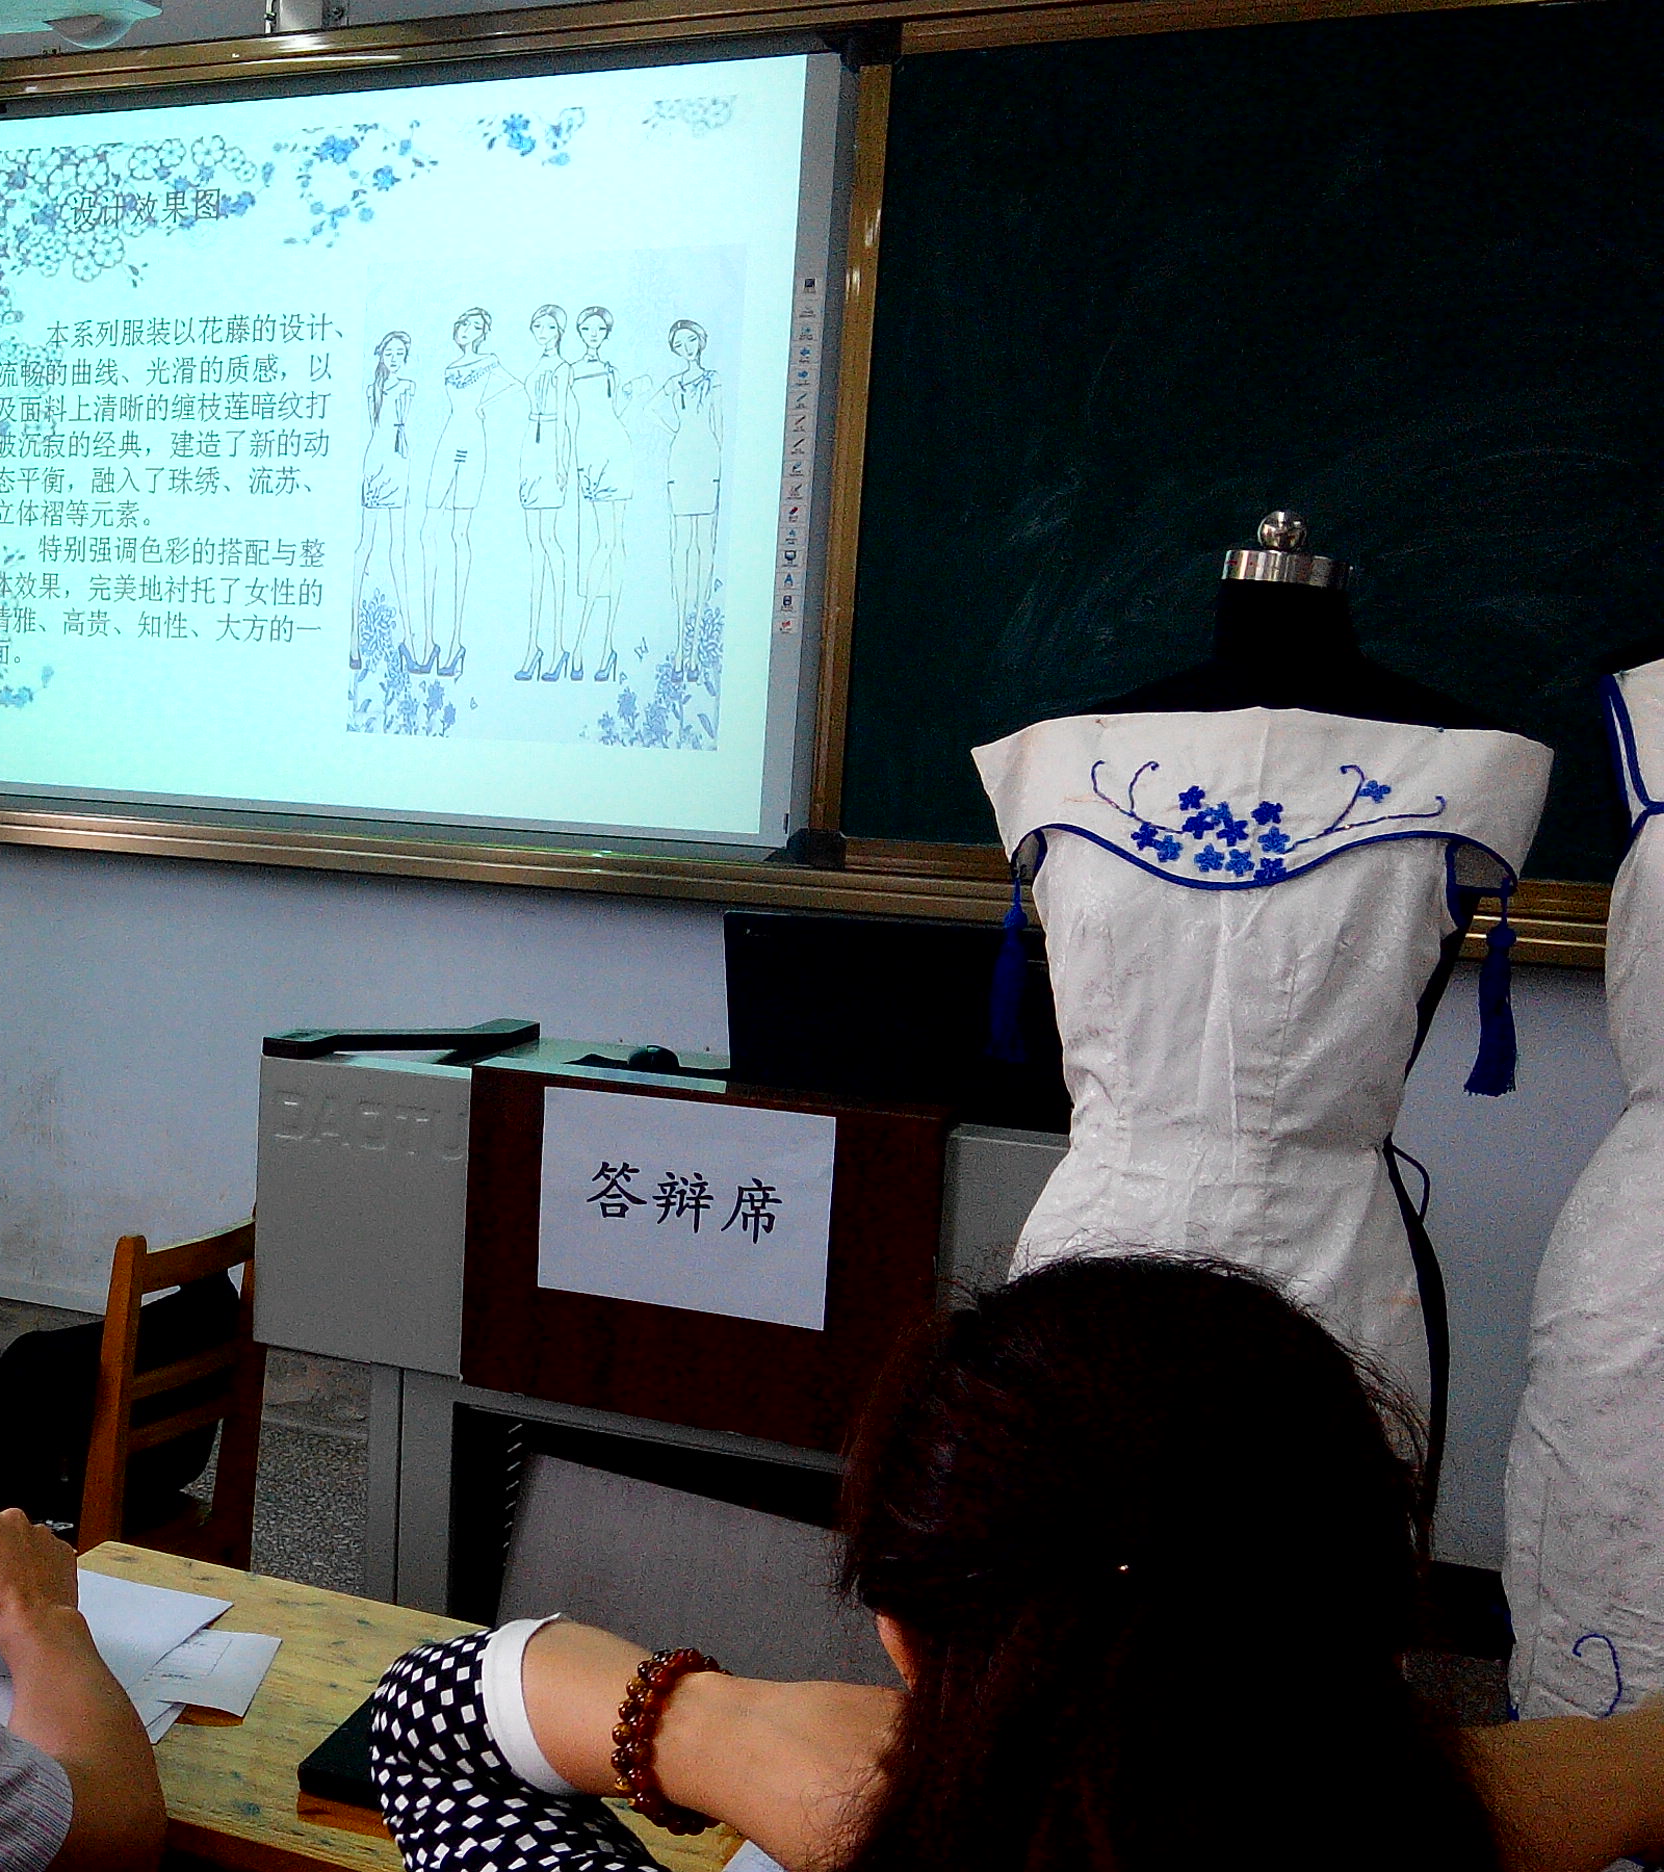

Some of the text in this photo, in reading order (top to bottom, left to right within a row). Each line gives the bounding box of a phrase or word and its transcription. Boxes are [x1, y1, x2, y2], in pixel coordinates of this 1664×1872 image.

[71, 188, 221, 229] 设计效果图
[38, 535, 326, 568] 特别强调色彩的搭配与整
[586, 1161, 783, 1244] 答辩席
